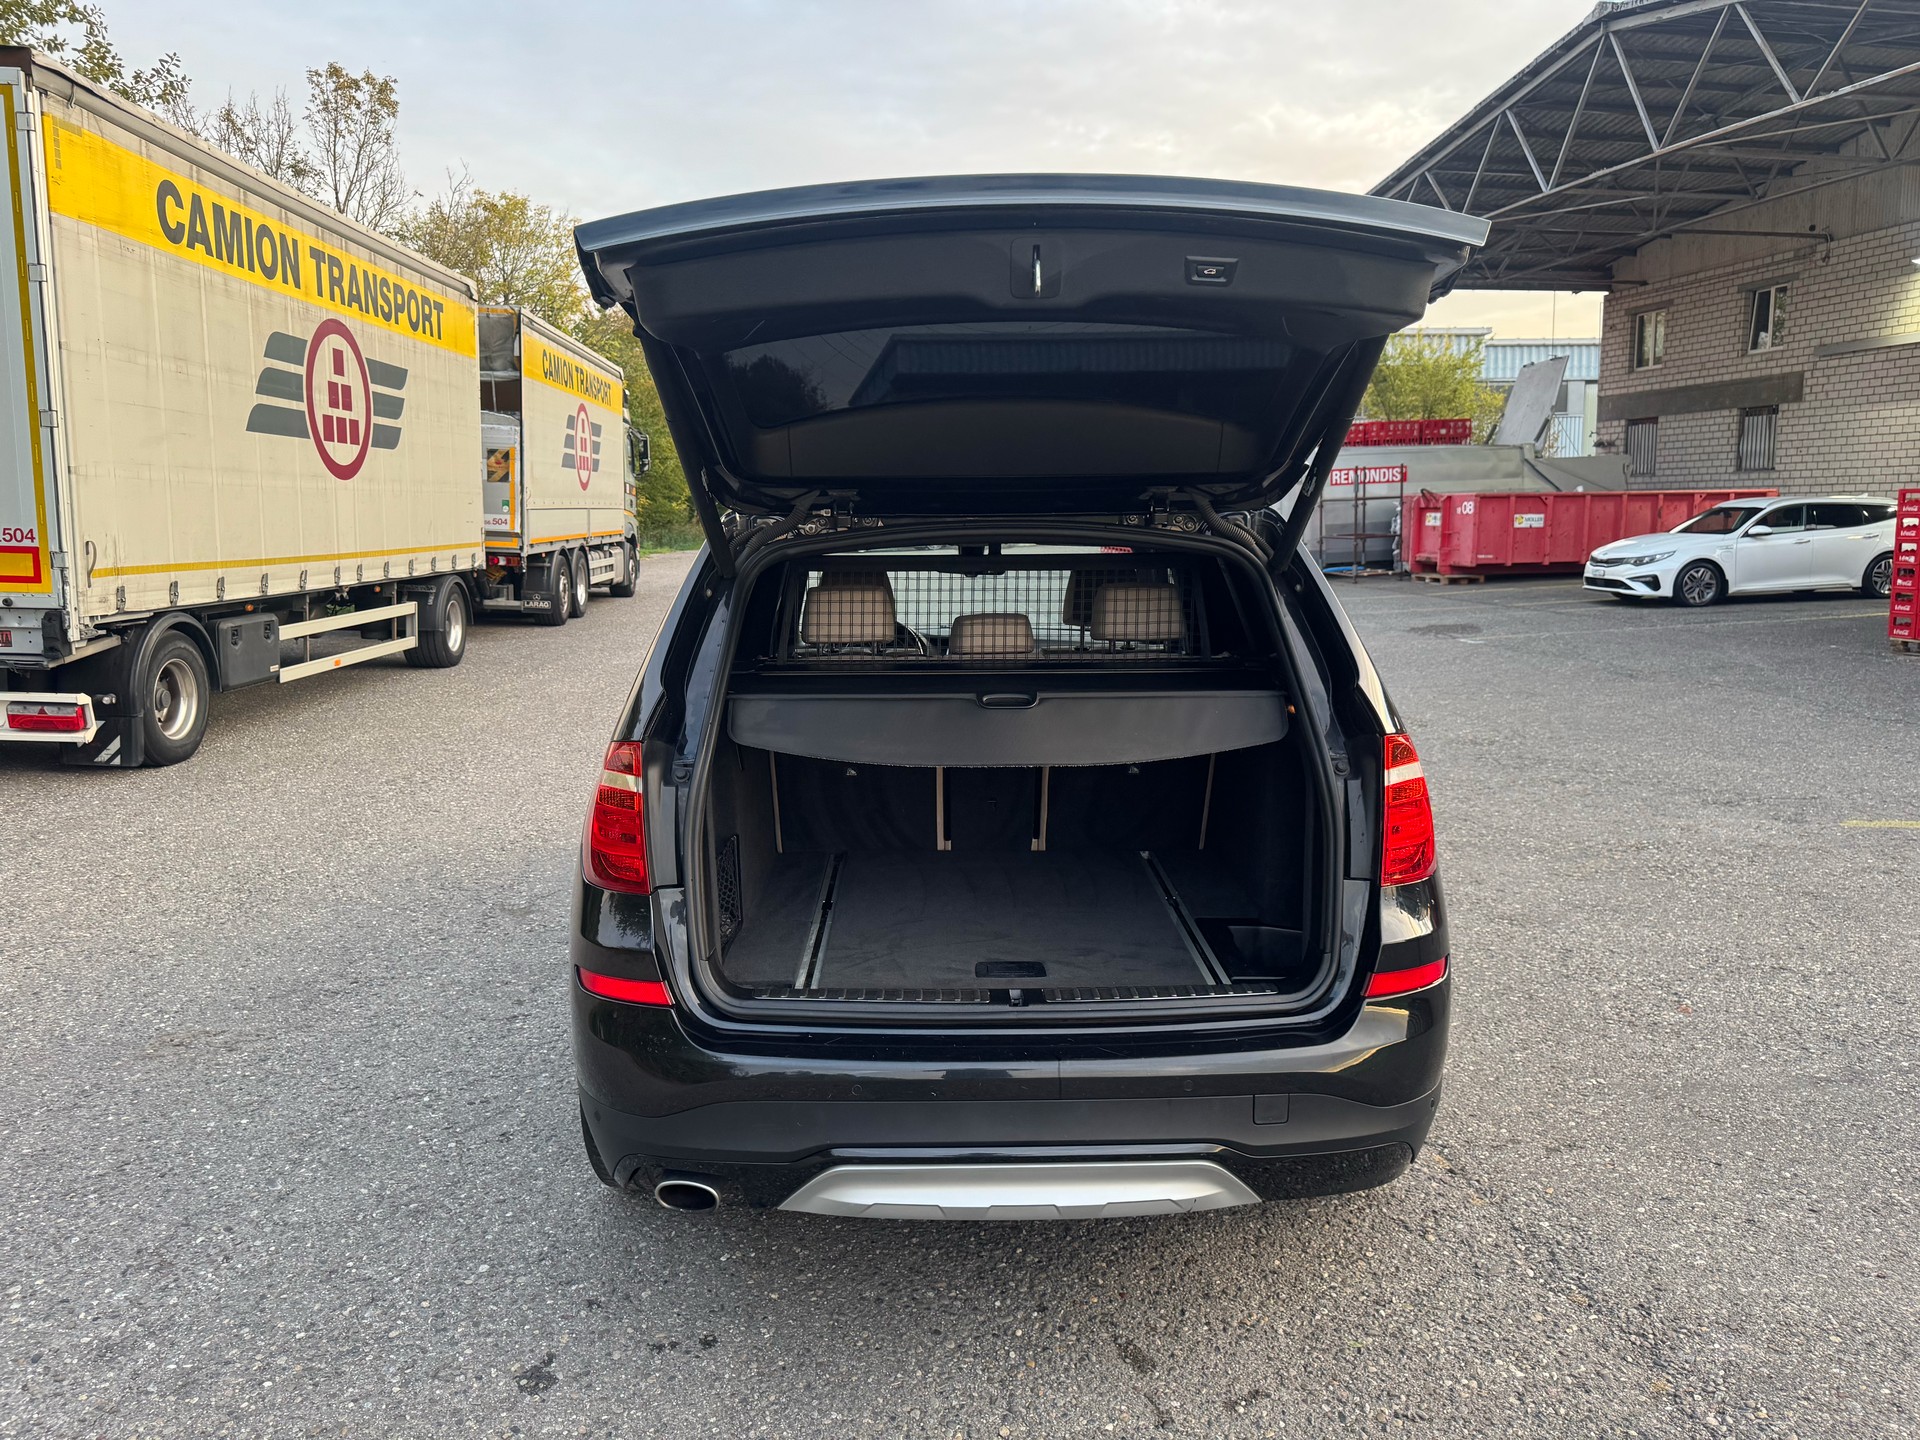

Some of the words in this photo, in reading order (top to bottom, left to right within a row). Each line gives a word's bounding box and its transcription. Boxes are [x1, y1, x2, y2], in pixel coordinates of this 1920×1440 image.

[156, 179, 301, 290] CAMION
[309, 245, 444, 341] TRANSPORT
[542, 348, 574, 390] CAMION
[574, 365, 612, 407] TRANSPORT
